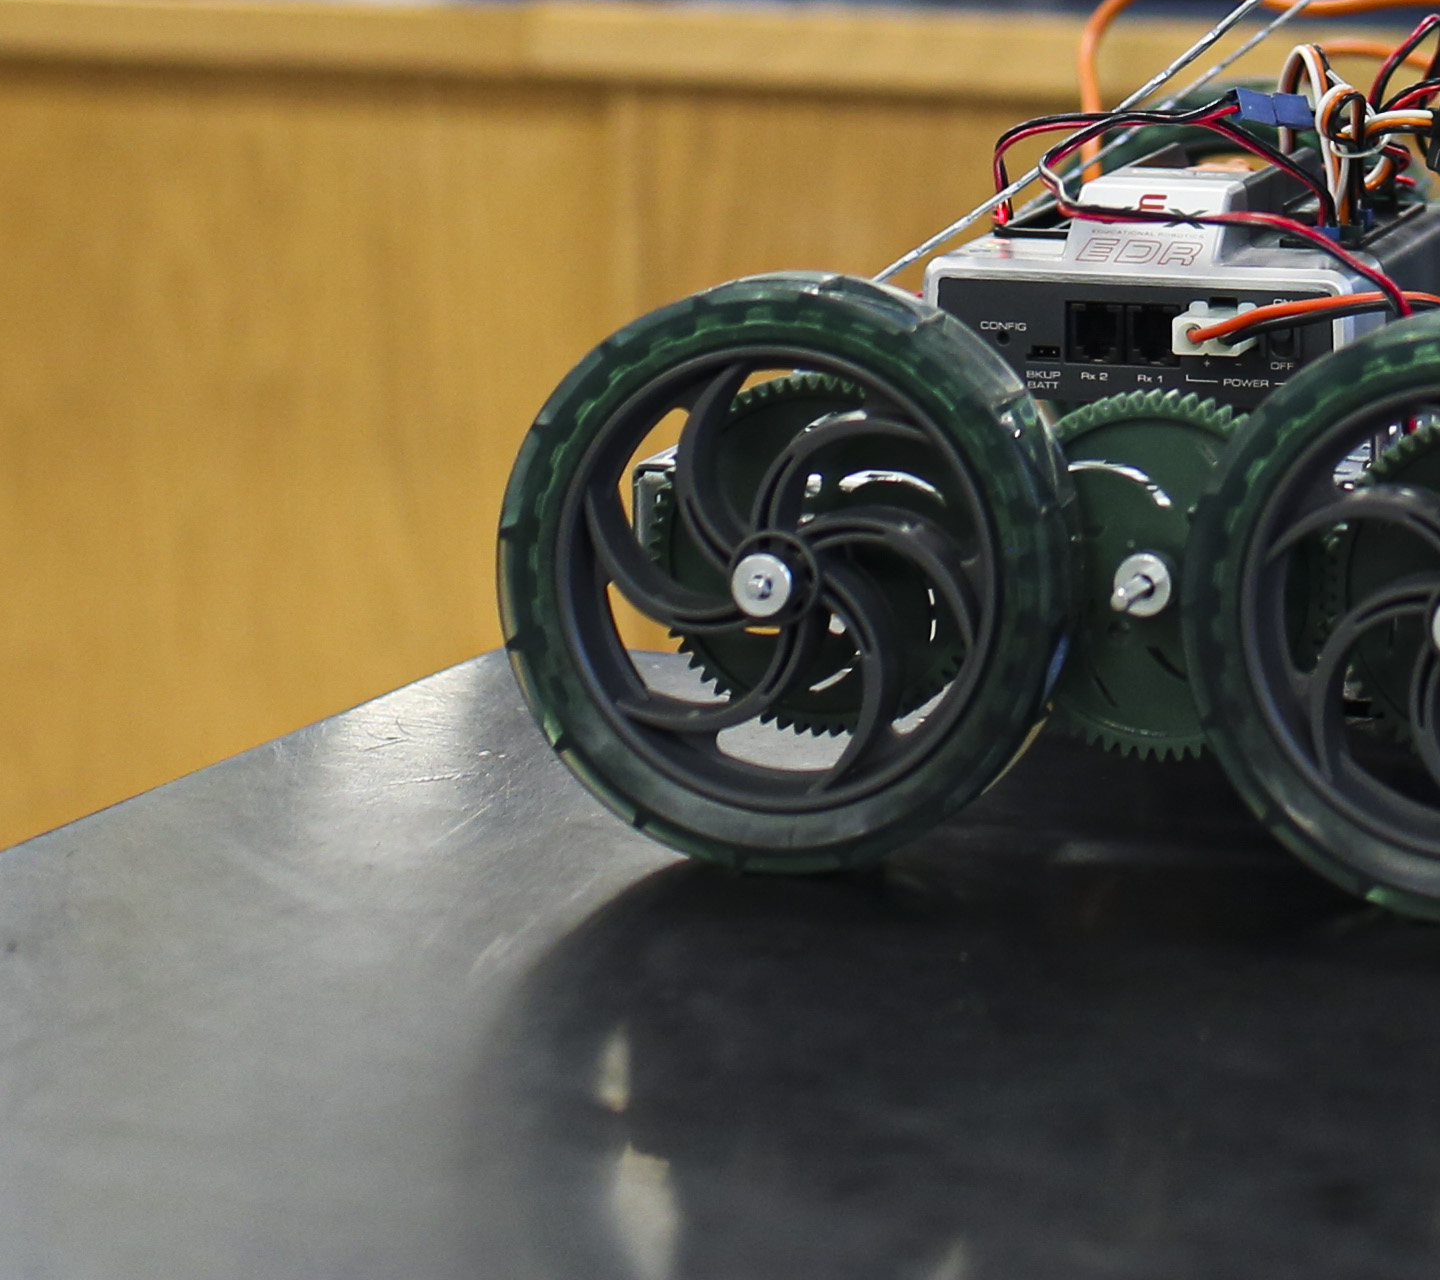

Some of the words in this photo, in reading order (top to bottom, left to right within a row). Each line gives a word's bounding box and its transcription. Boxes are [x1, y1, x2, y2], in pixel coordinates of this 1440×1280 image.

[1092, 229, 1153, 237] EDUCATIONAL
[1075, 237, 1204, 267] EDR
[980, 321, 1027, 331] CONFIG
[1270, 362, 1294, 371] OFF
[1026, 371, 1061, 379] BKUP
[1081, 371, 1095, 380] Rx
[1099, 372, 1108, 380] 2
[1137, 374, 1152, 383] Rx
[1157, 375, 1163, 383] 1
[1027, 381, 1059, 389] BATT
[1223, 378, 1269, 387] POWER
